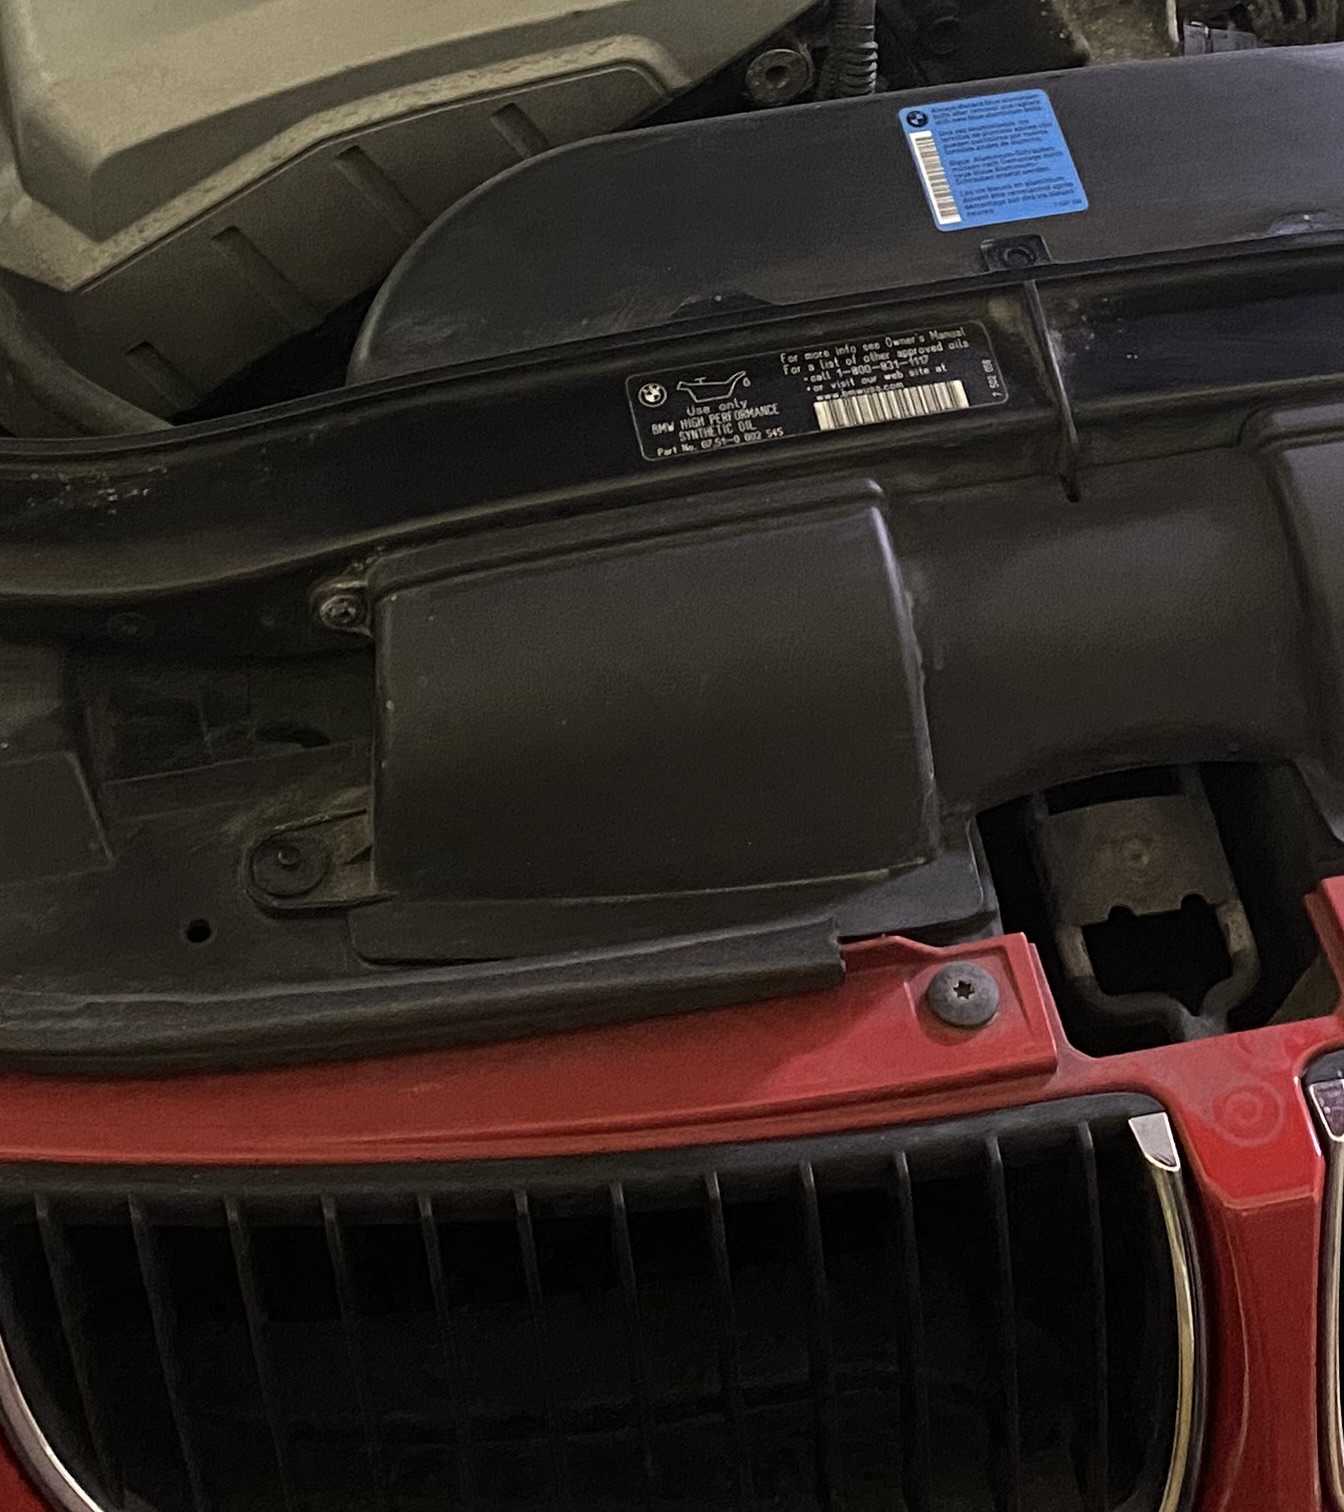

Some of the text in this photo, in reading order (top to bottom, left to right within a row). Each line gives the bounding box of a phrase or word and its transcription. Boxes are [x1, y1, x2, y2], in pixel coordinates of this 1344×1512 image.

[780, 326, 966, 364] For more info see Owner's Manual
[783, 338, 970, 375] For a list of other approved oils
[831, 377, 855, 389] visit
[861, 376, 877, 384] our
[884, 370, 904, 381] web
[908, 367, 930, 377] site
[936, 363, 947, 373] at
[836, 354, 929, 378] 1-800-831-1117
[651, 403, 780, 435] BMW HIGH PERFORMANCE
[686, 398, 748, 417] Use only
[679, 420, 758, 442] SYNTHETIC OIL
[657, 446, 677, 457] Part
